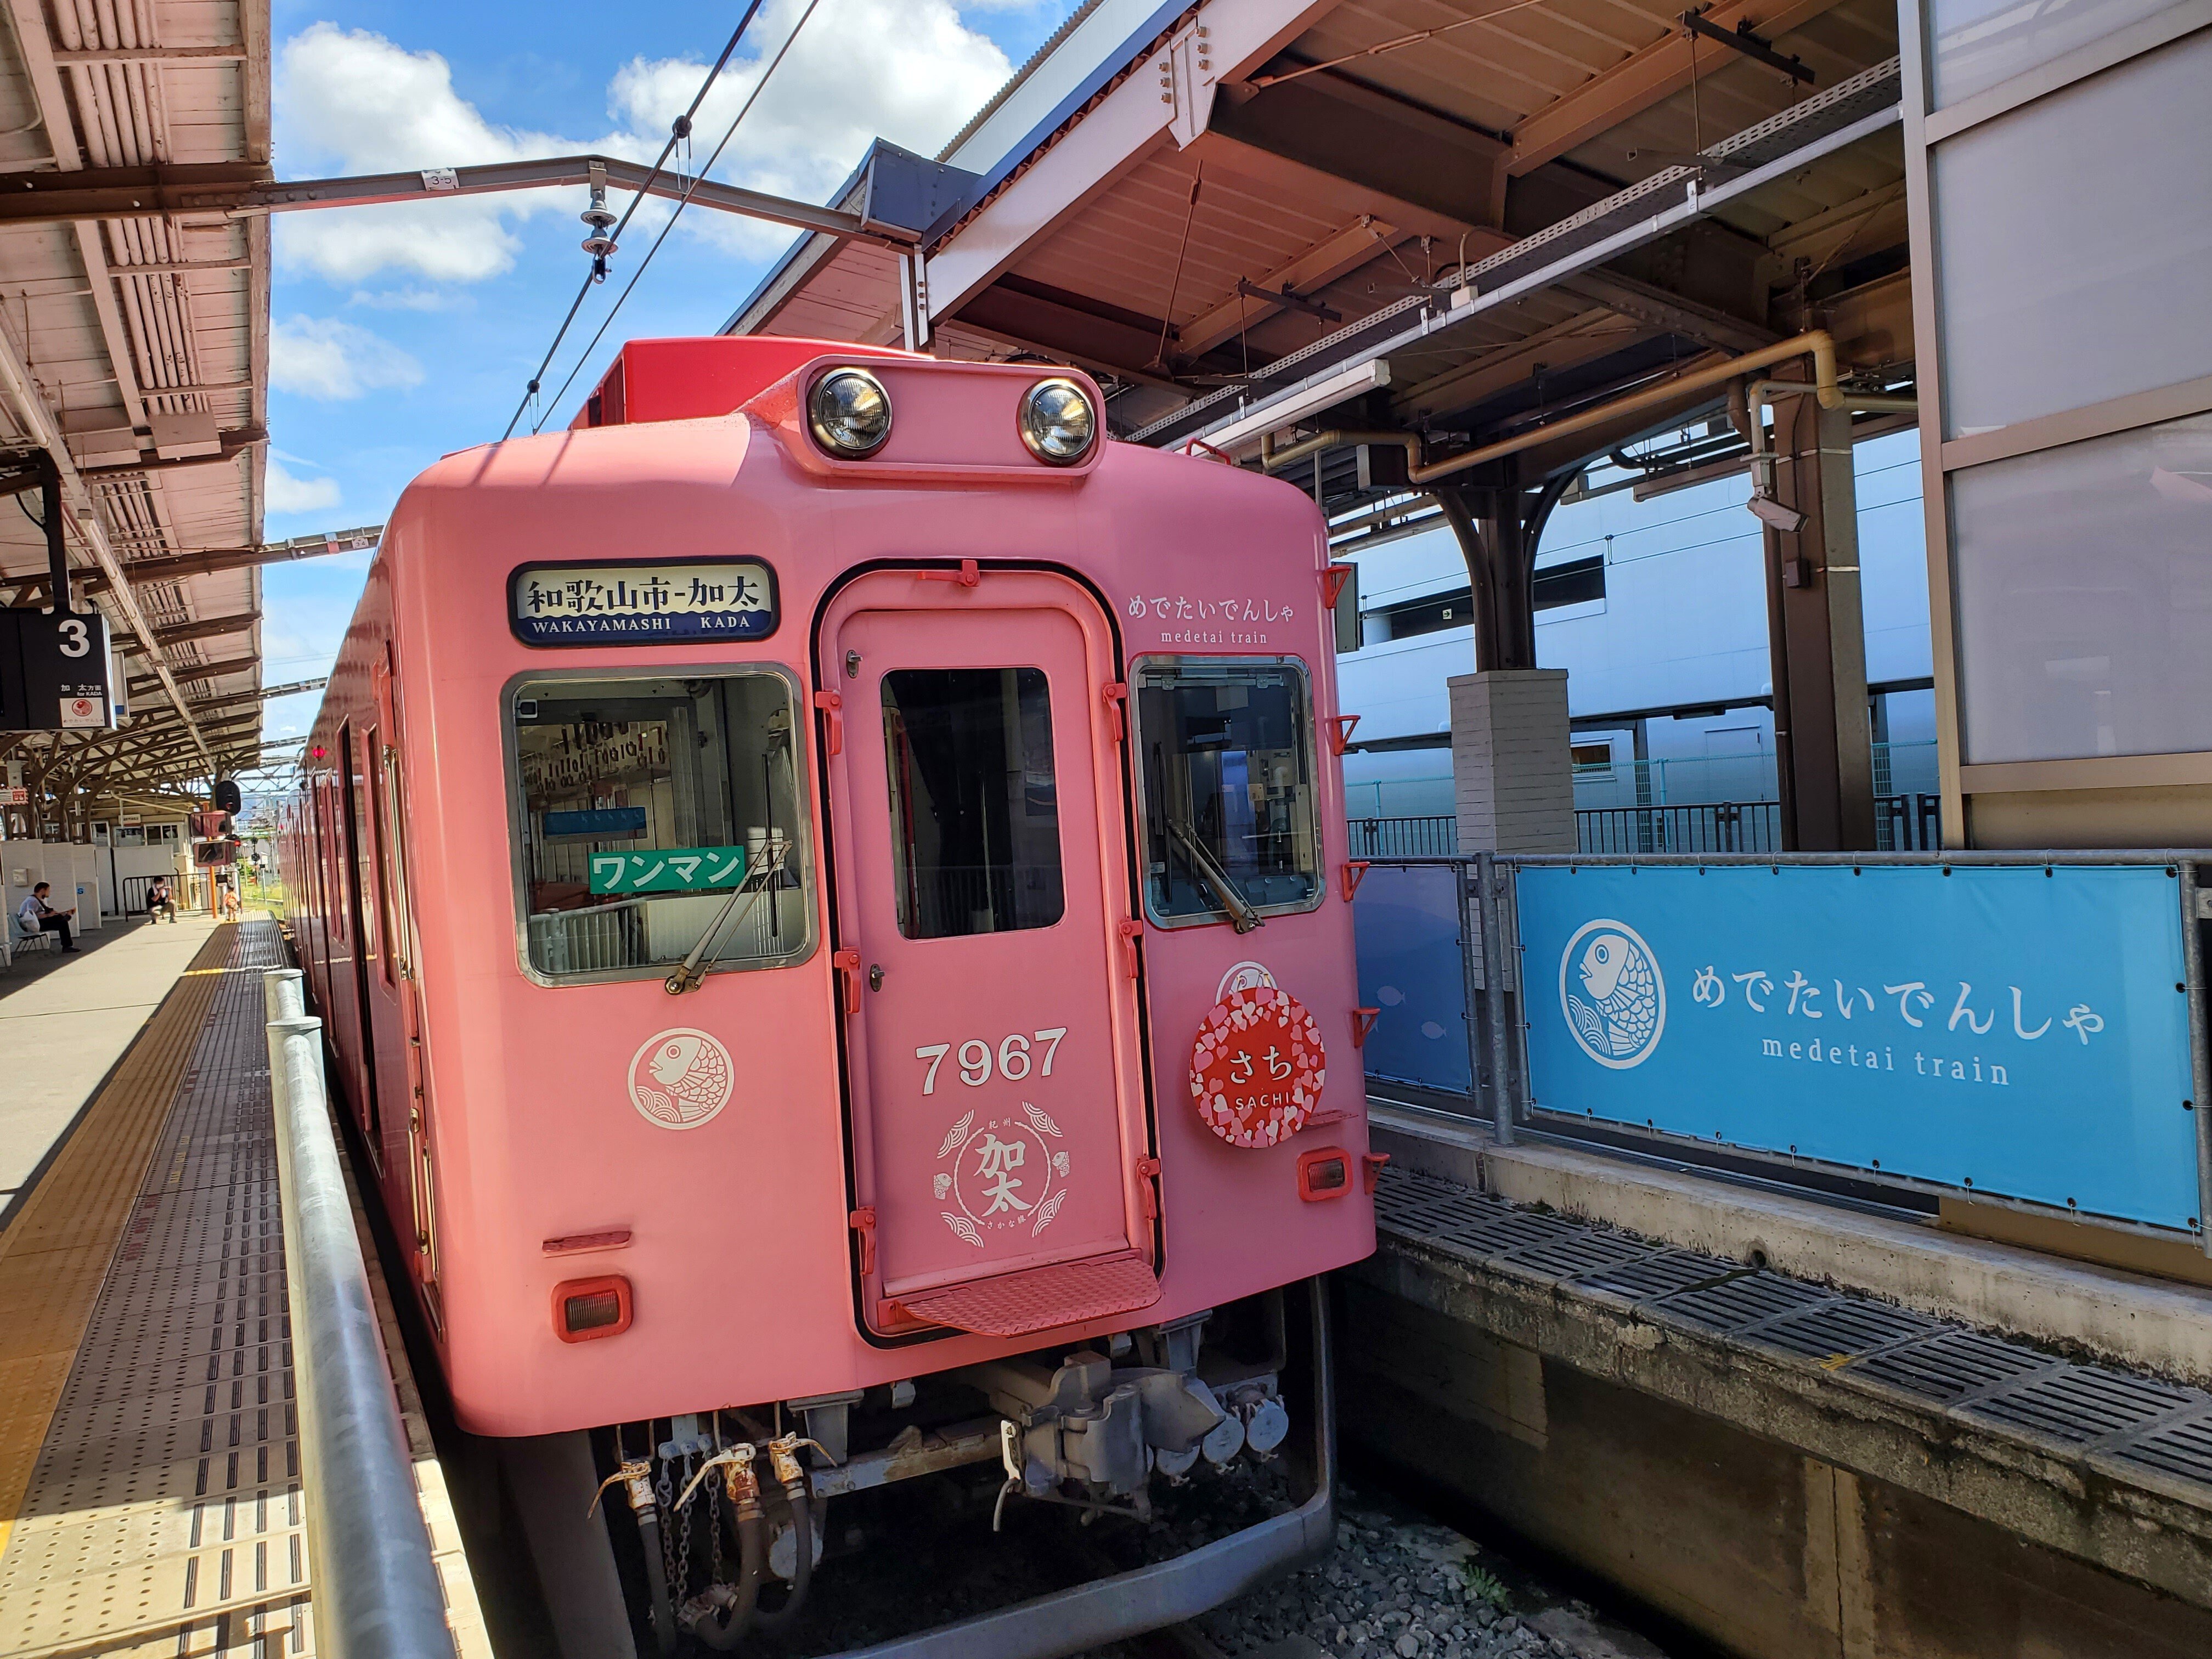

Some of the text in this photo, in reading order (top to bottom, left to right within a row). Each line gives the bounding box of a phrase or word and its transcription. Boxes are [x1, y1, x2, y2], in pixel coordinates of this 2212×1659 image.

[431, 176, 452, 185] 3-5
[532, 616, 751, 634] WAKAYAMASHI KADA
[1127, 595, 1294, 623] めでたいでんしゃ
[59, 619, 91, 658] 3
[1160, 630, 1268, 644] medetai train
[593, 851, 740, 890] ワンマン
[1692, 964, 2106, 1046] めでたいでんしゃ
[916, 1027, 1068, 1096] 7967
[1229, 1045, 1292, 1084] さち
[1762, 1037, 2010, 1086] medetai train
[1235, 1091, 1289, 1110] SACHI
[989, 1117, 1011, 1130] 紀州
[973, 1133, 1033, 1217] 加太
